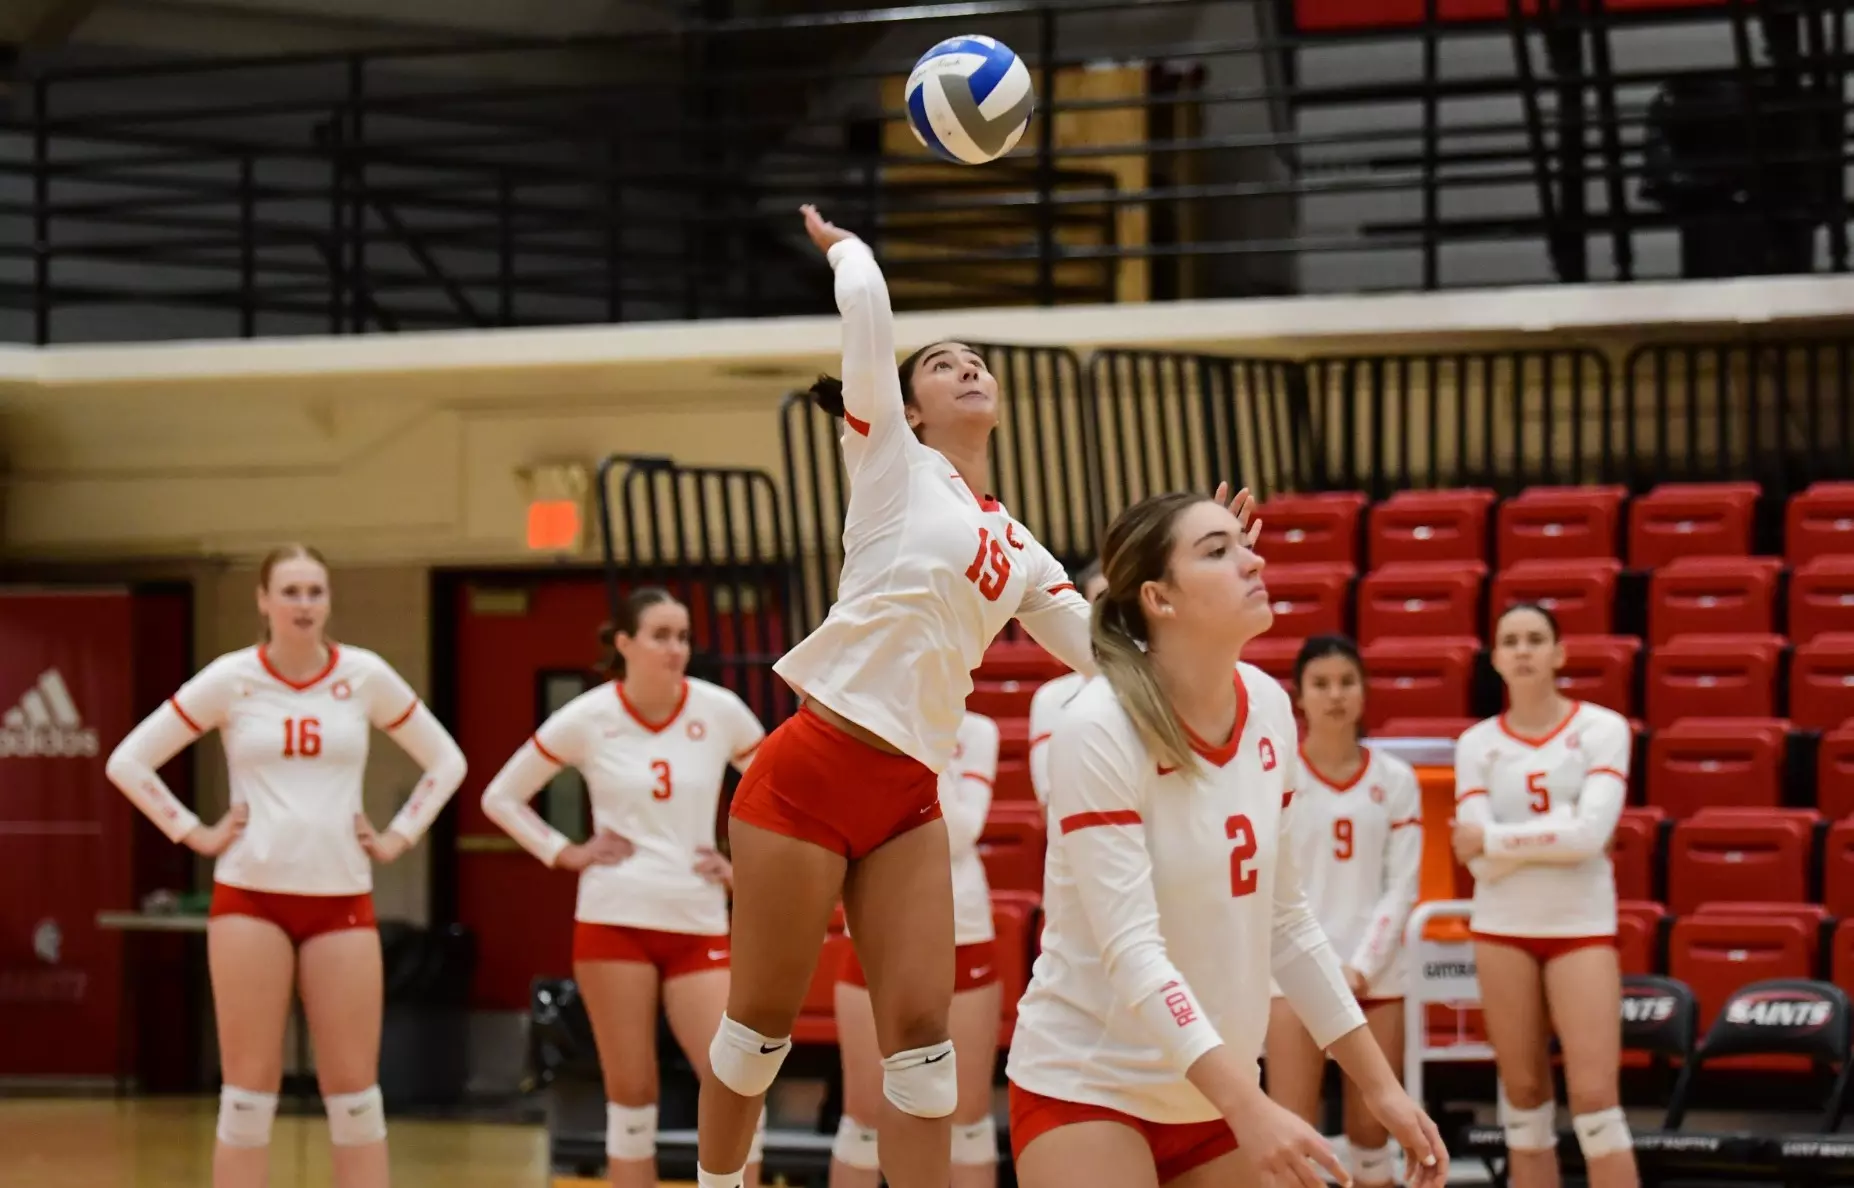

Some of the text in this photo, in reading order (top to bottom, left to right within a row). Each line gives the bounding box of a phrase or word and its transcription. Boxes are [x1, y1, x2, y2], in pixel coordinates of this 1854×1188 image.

[965, 527, 1011, 602] 19
[282, 717, 322, 758] 16
[650, 760, 674, 802] 3
[1525, 771, 1551, 814] 5
[1224, 813, 1259, 898] 2
[1332, 818, 1355, 861] 9
[1726, 1000, 1833, 1027] SAINTS
